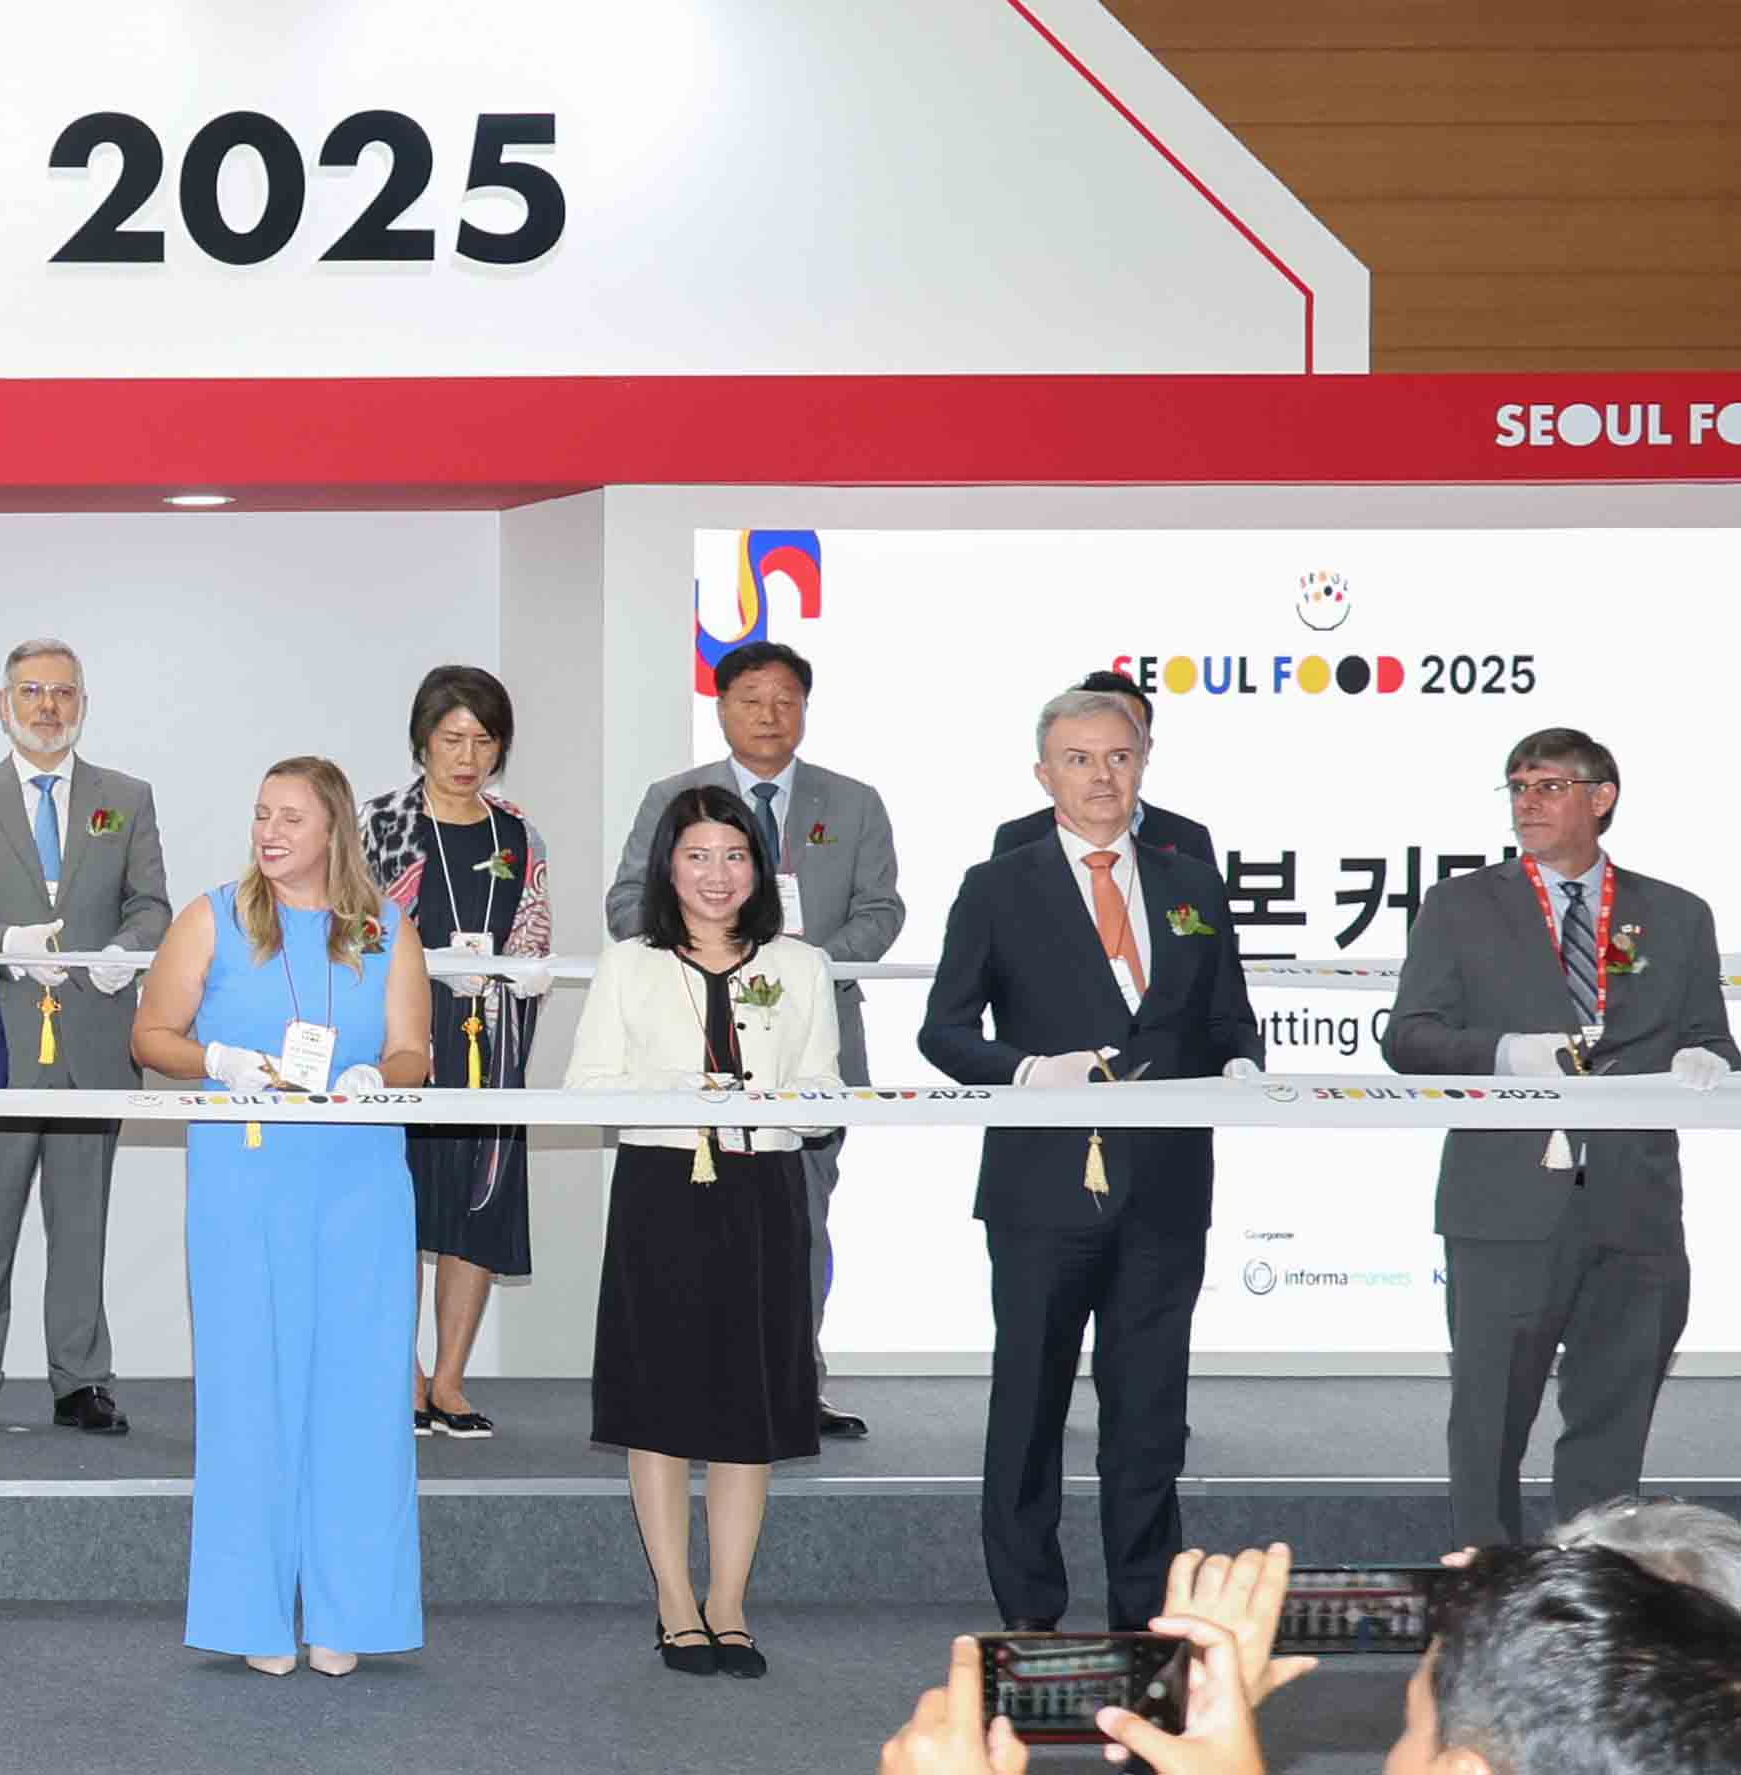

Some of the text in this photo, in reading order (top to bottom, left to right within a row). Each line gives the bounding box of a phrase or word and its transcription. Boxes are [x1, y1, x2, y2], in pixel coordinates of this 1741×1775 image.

[48, 110, 567, 266] 2025
[1495, 403, 1741, 447] SEOUL FO
[1273, 655, 1405, 695] FOOD
[1421, 654, 1537, 695] 2025
[1227, 850, 1307, 960] 본
[356, 1094, 423, 1105] 2025
[1491, 1089, 1561, 1100] 2025
[1284, 1269, 1349, 1286] informa
